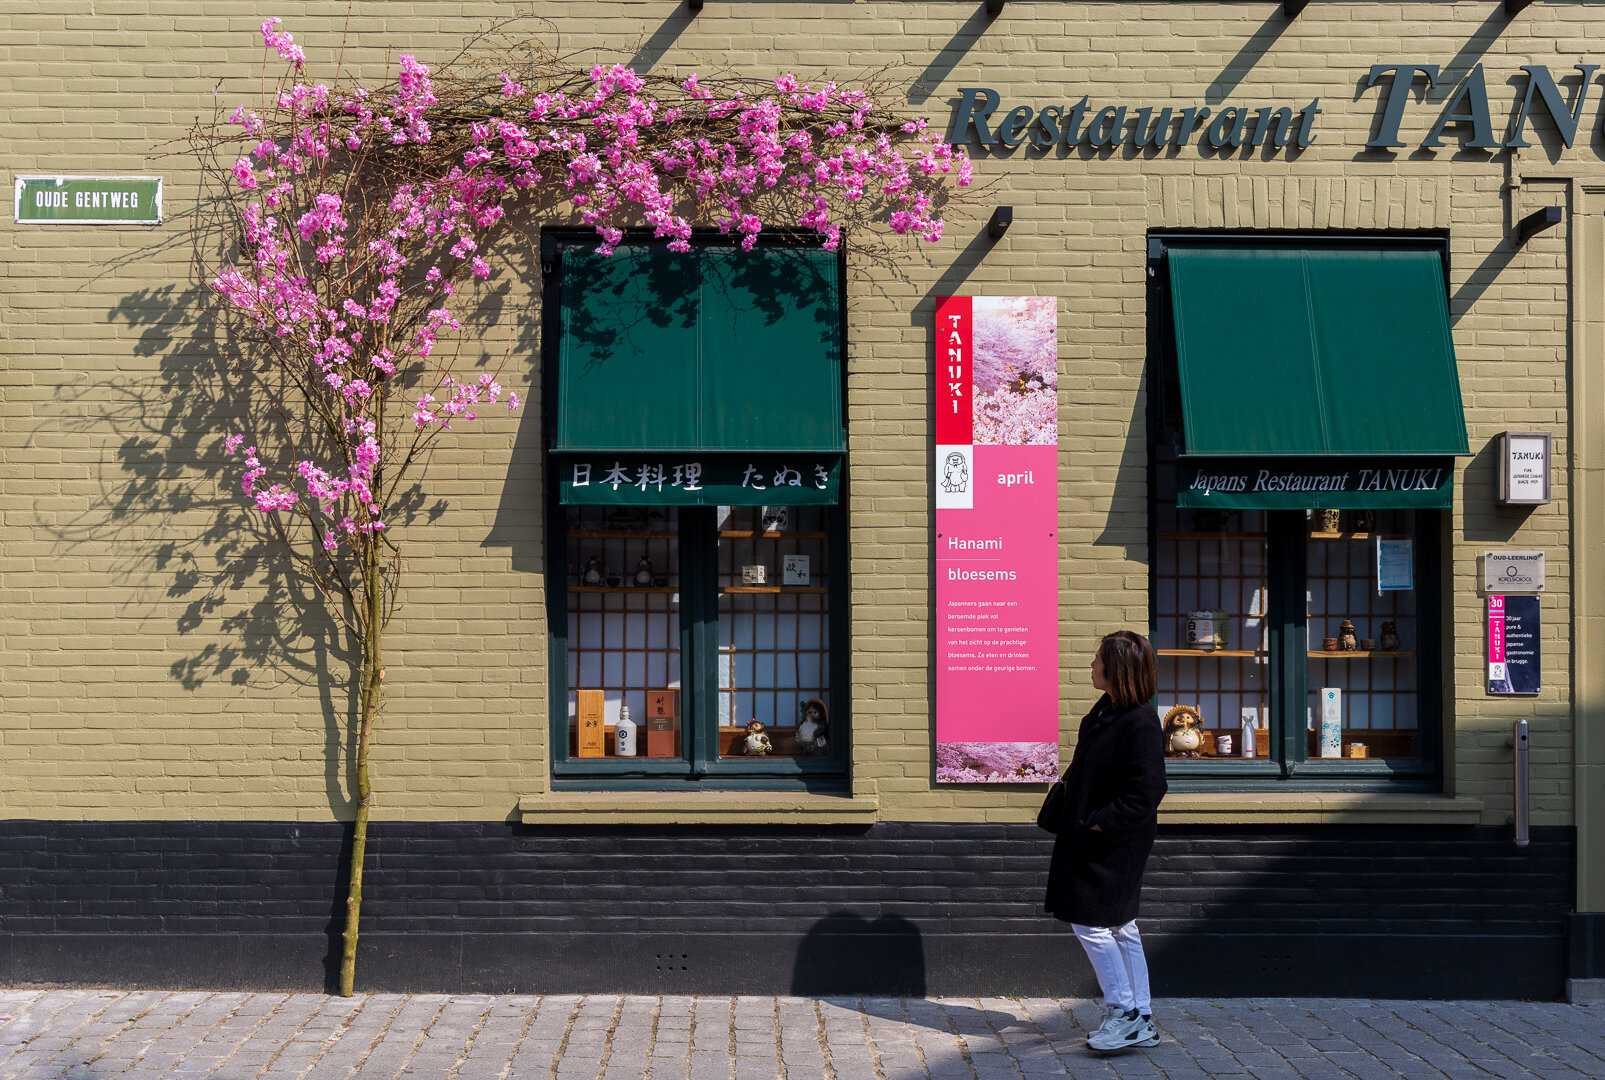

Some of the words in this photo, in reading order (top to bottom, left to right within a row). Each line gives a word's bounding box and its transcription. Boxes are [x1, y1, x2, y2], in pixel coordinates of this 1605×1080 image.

[948, 87, 1322, 148] Restaurant
[1366, 62, 1605, 150] TAN
[35, 191, 69, 207] OUDE
[75, 191, 139, 208] GENTWEG
[948, 315, 963, 414] TANUKI
[1511, 452, 1544, 460] TANUKI
[572, 462, 703, 492] 日本料理
[742, 463, 829, 490] たぬき
[997, 471, 1034, 487] april
[1189, 469, 1248, 496] Japans
[1252, 469, 1349, 491] Restaurant
[1356, 468, 1443, 491] TANUKI
[948, 536, 1003, 550] Hanami
[948, 567, 1017, 581] bloesems
[947, 600, 977, 608] Japanners
[1490, 599, 1503, 608] 30
[1003, 626, 1029, 634] genieten
[1000, 639, 1027, 647] prachtige
[993, 665, 1015, 673] geurige
